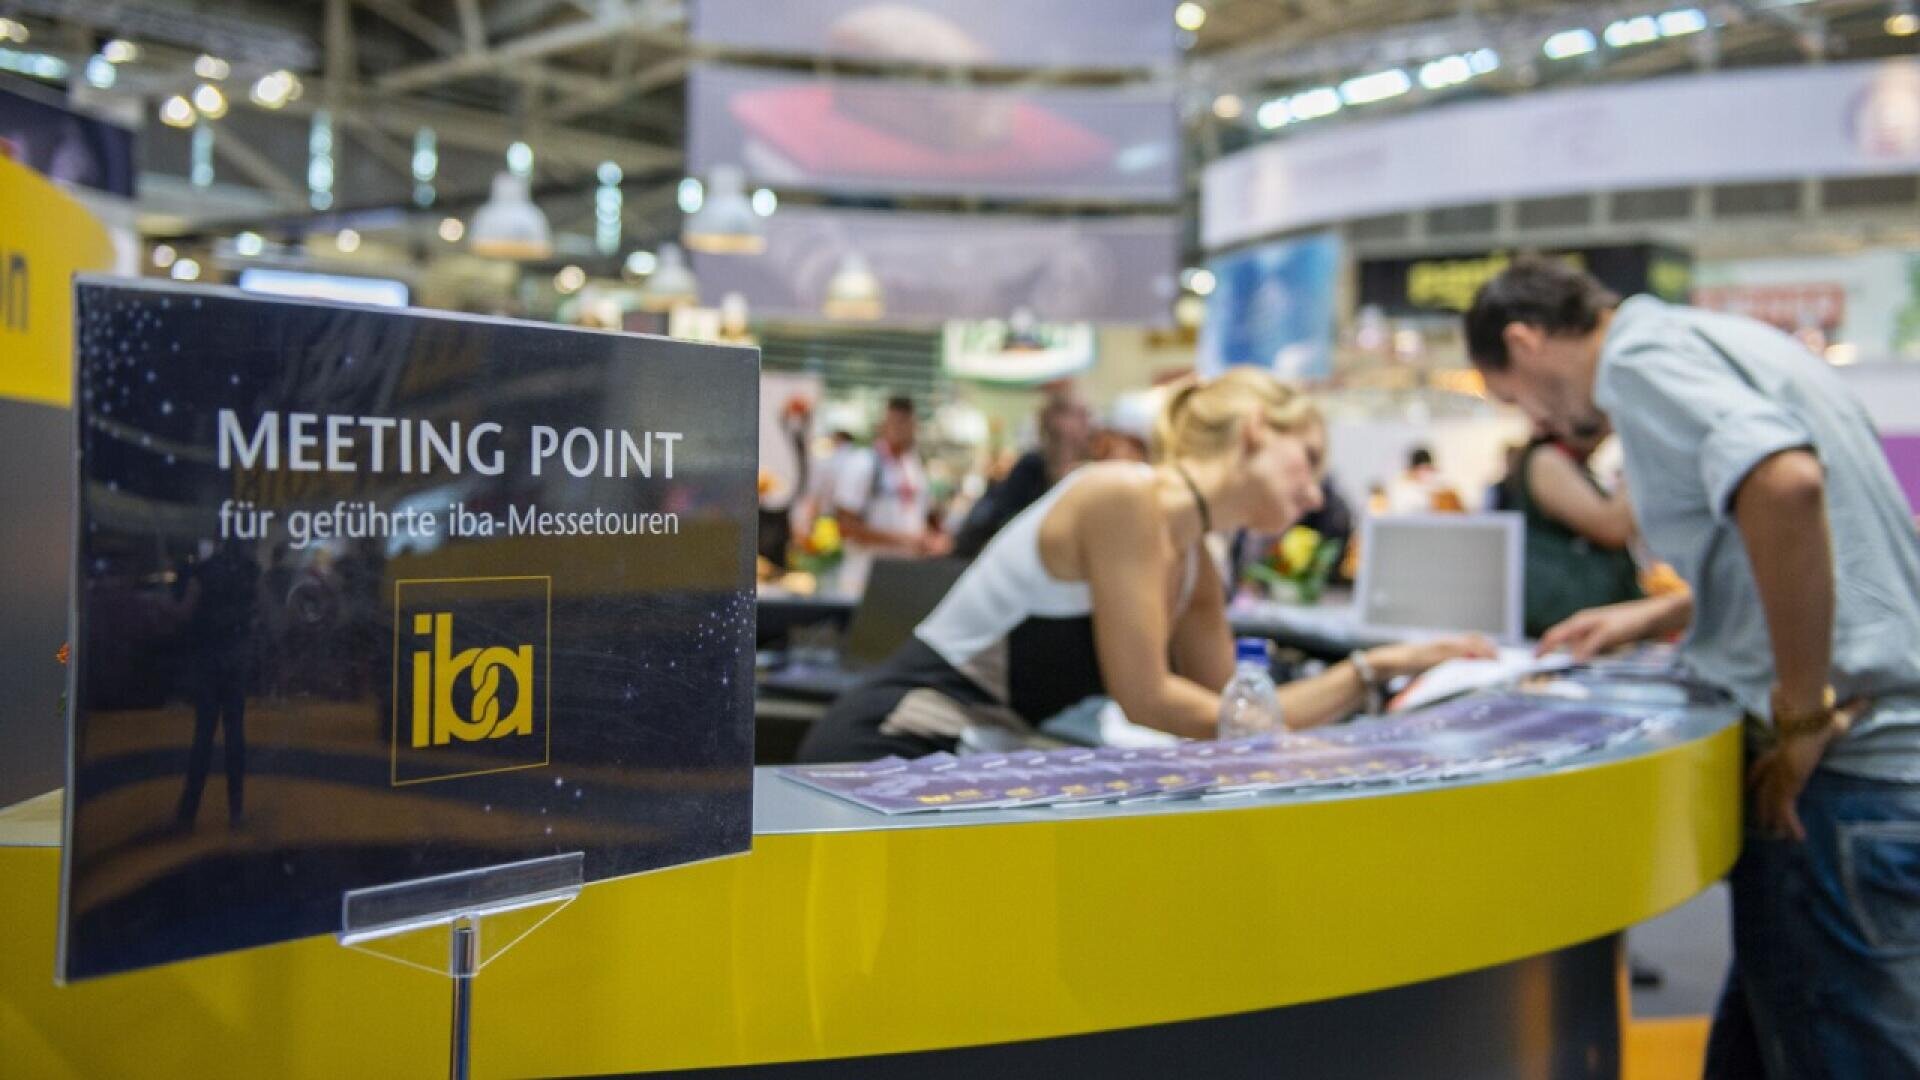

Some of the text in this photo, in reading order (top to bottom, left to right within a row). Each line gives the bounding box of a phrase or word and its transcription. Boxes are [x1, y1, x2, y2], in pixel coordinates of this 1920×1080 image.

[217, 408, 684, 480] MEETING POINT
[218, 500, 680, 549] für geführte iba-Messetouren
[412, 611, 534, 748] iba
